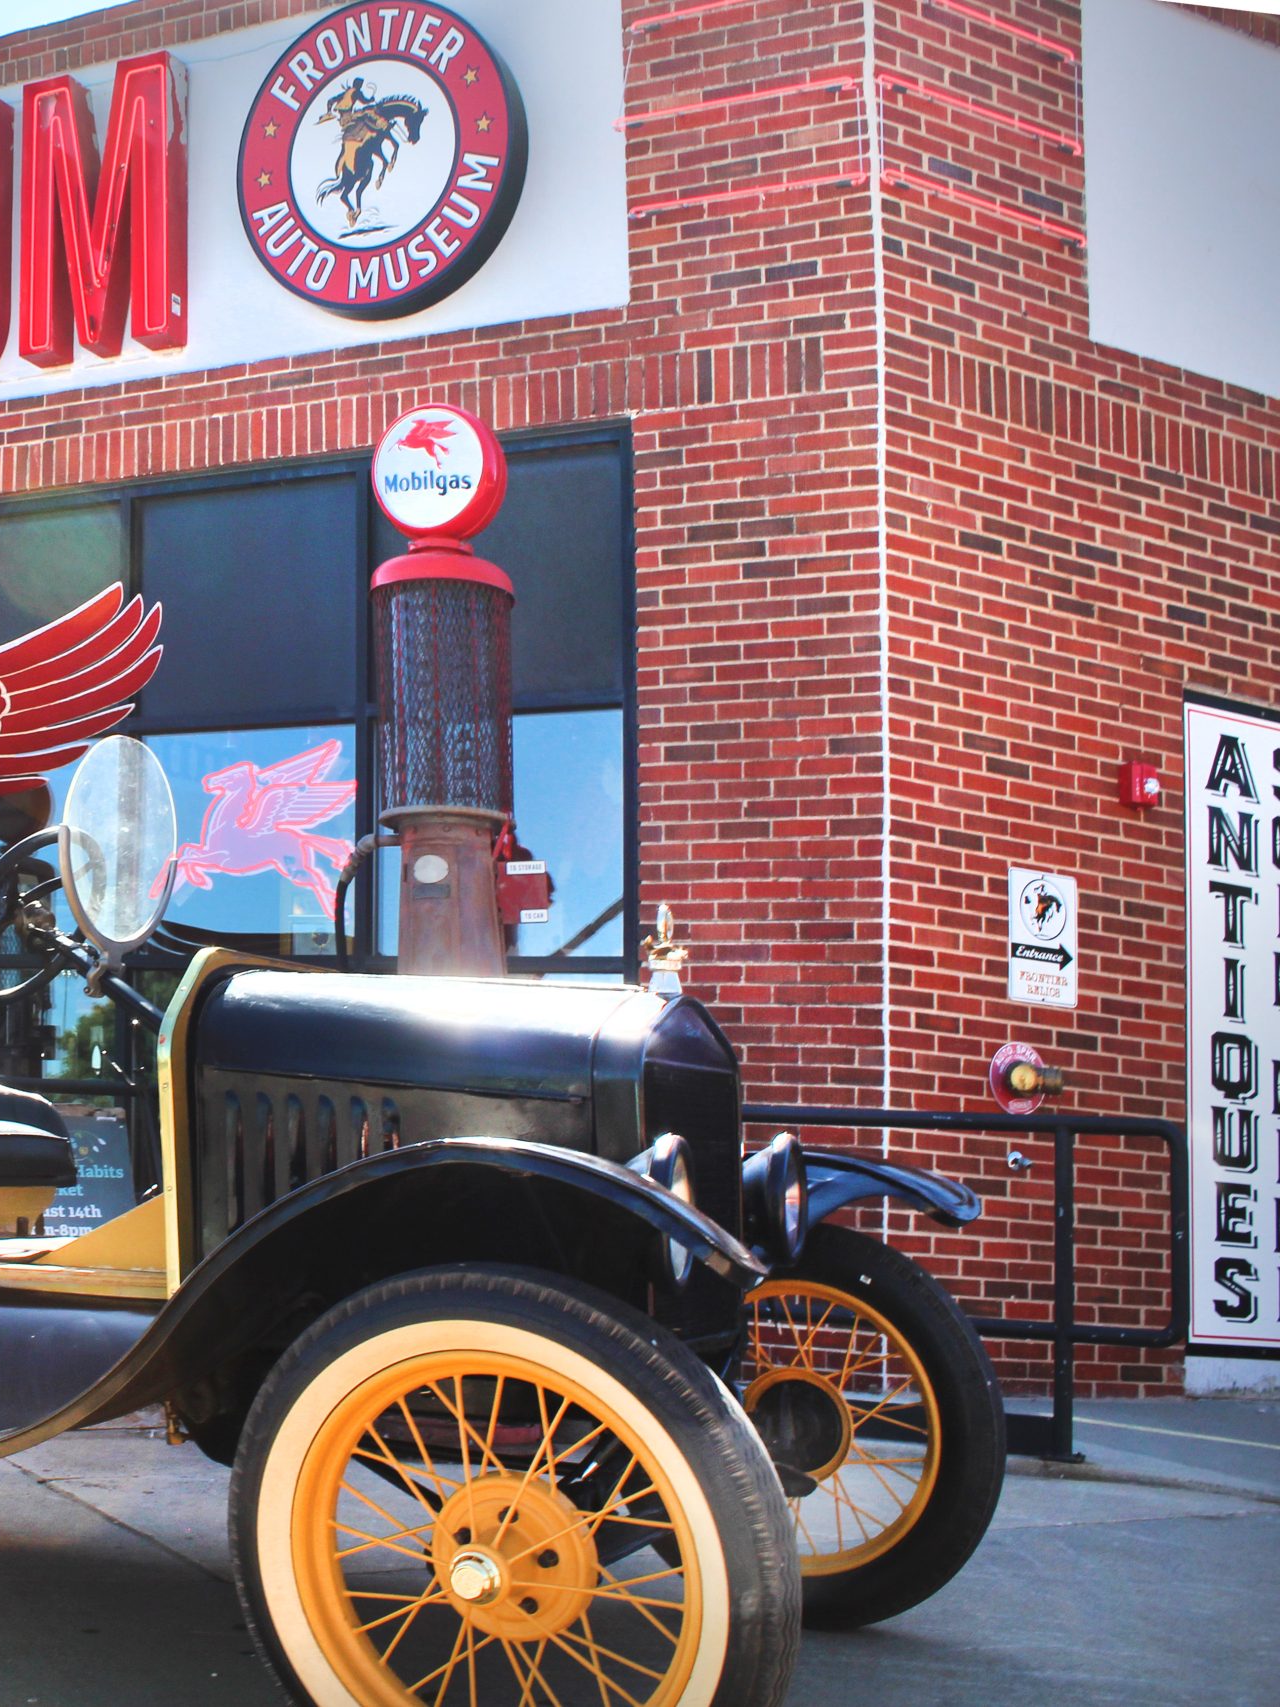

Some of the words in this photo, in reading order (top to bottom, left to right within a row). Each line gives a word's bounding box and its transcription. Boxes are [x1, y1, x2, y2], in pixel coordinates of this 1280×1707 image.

[270, 8, 465, 111] FRONTIER
[252, 200, 336, 291] AUTO
[348, 152, 500, 300] MUSEUM
[384, 470, 472, 496] Mobilgas
[1015, 945, 1064, 963] Entrance
[1018, 970, 1069, 987] FRONTIER
[1026, 984, 1062, 999] RELICS
[1204, 733, 1261, 1323] ANTIQUES
[68, 1205, 102, 1218] 14th
